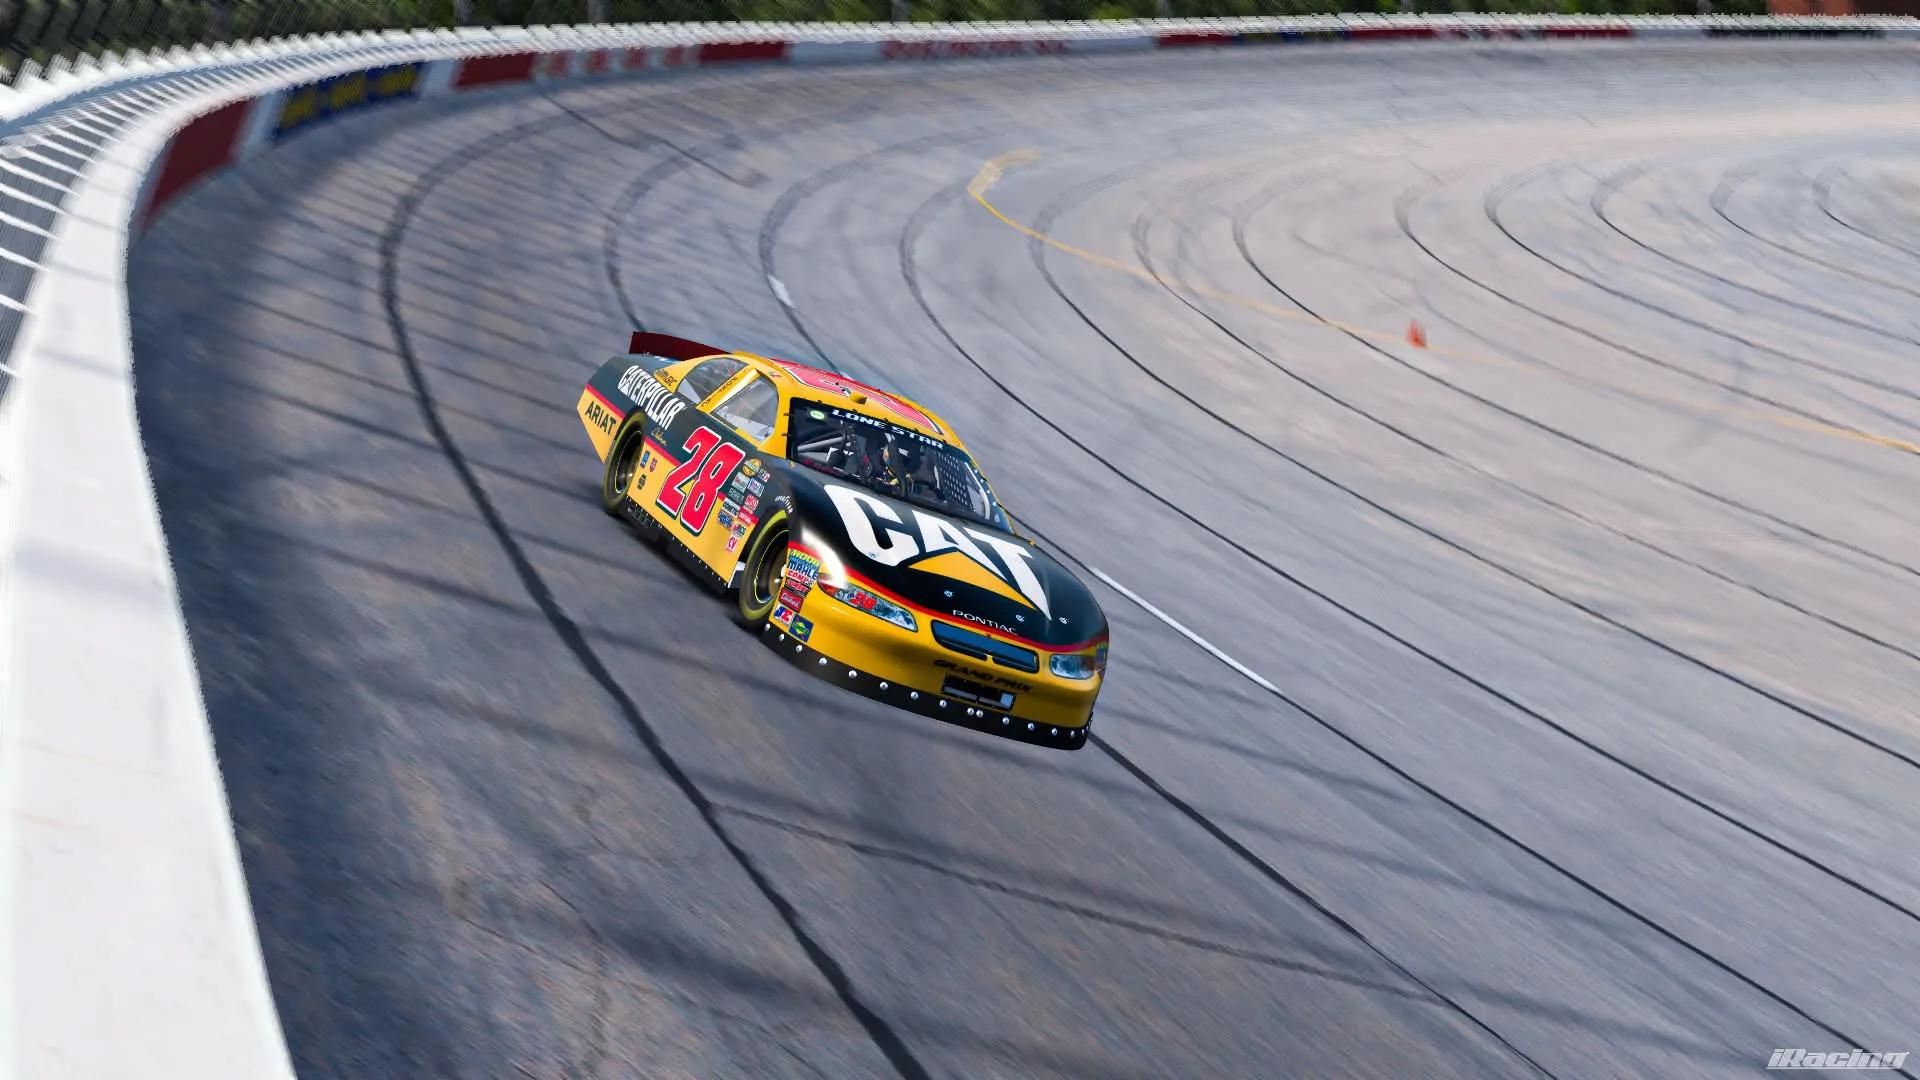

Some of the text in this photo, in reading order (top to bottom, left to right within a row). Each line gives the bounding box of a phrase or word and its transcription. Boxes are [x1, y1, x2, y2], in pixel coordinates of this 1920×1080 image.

[617, 365, 686, 430] CATERPILLAR
[585, 401, 616, 436] ARIAT
[831, 409, 944, 449] LONE STAR
[655, 425, 746, 537] 28
[788, 561, 819, 581] MAHLE
[823, 484, 1052, 621] CAT
[952, 609, 1019, 636] PONTIAC
[933, 659, 1034, 692] GRAND PRIX
